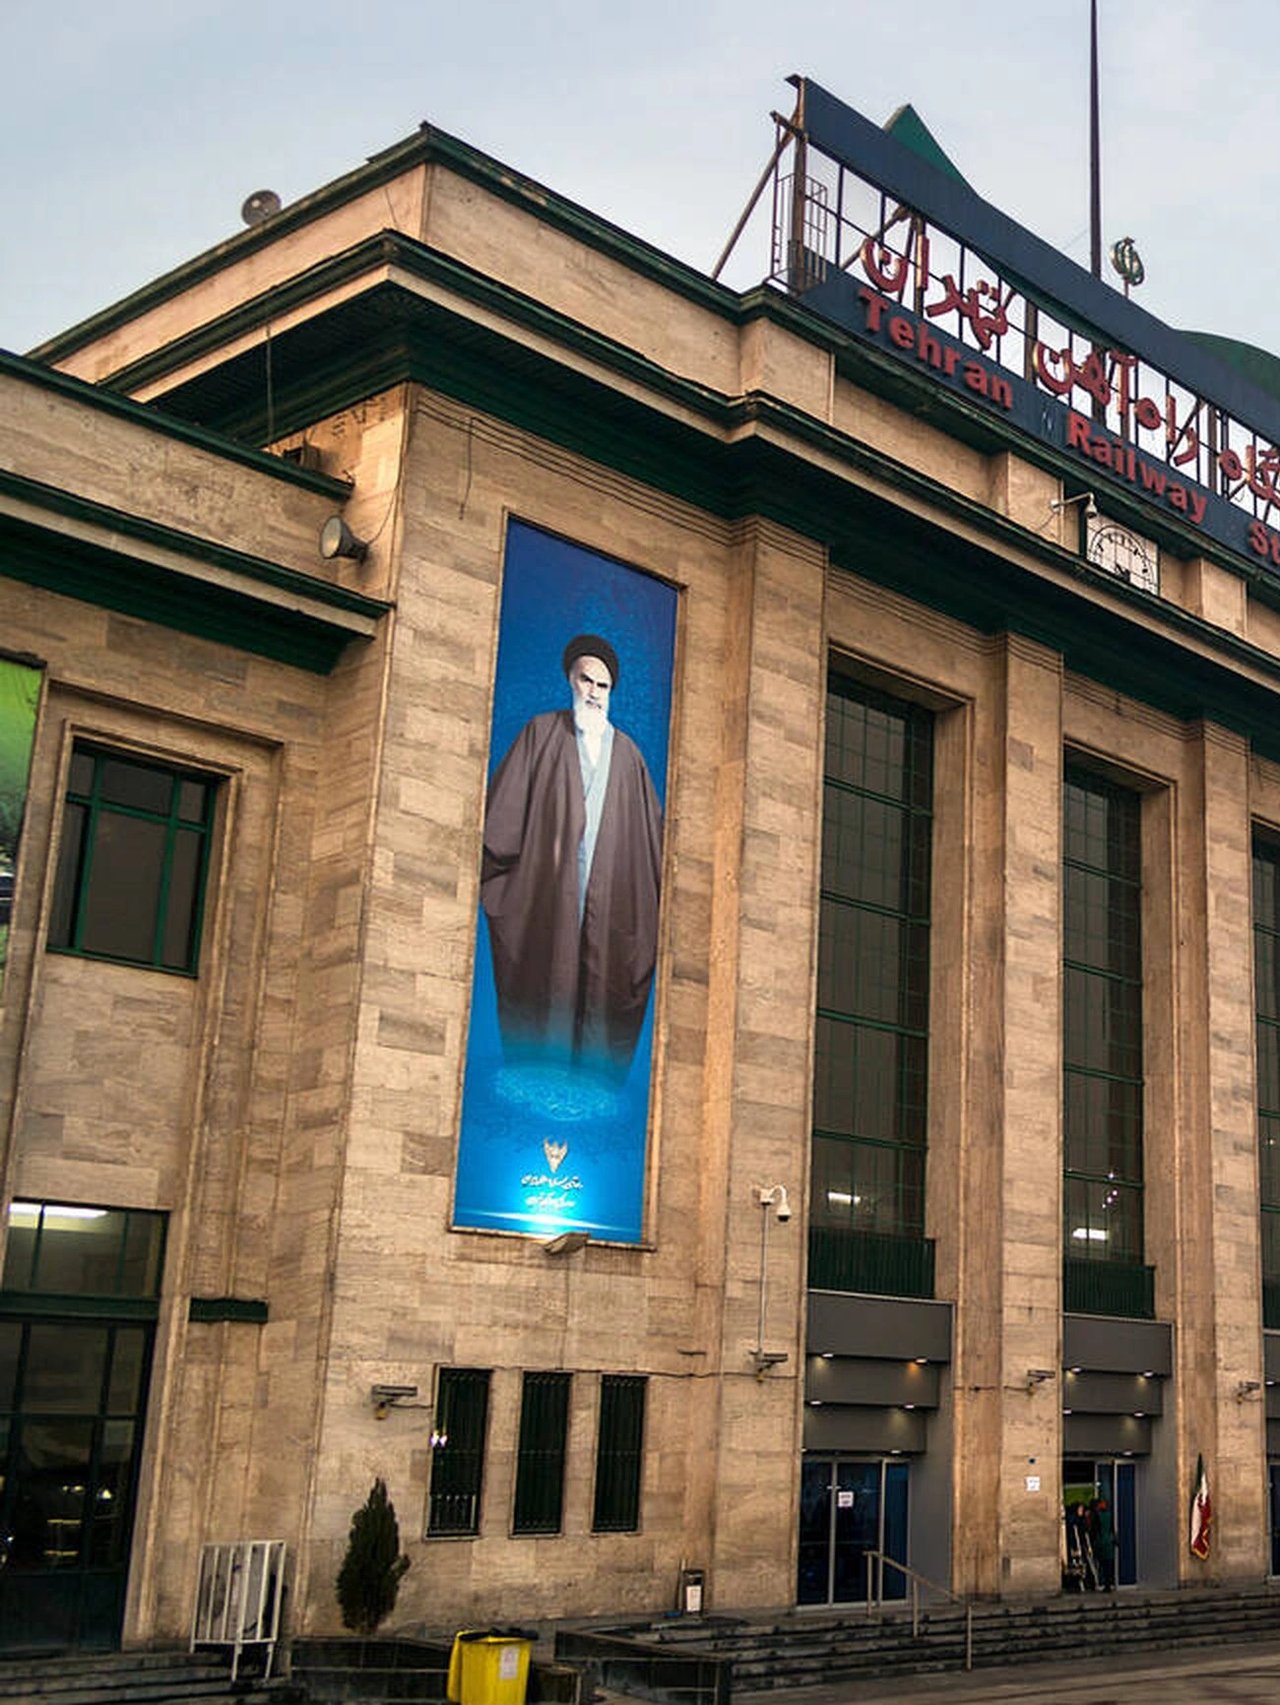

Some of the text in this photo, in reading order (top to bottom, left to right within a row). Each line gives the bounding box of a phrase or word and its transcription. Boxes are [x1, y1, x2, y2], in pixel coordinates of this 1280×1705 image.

[859, 234, 1009, 351] تهران
[857, 286, 1014, 410] Tehran
[1067, 409, 1208, 525] Railway
